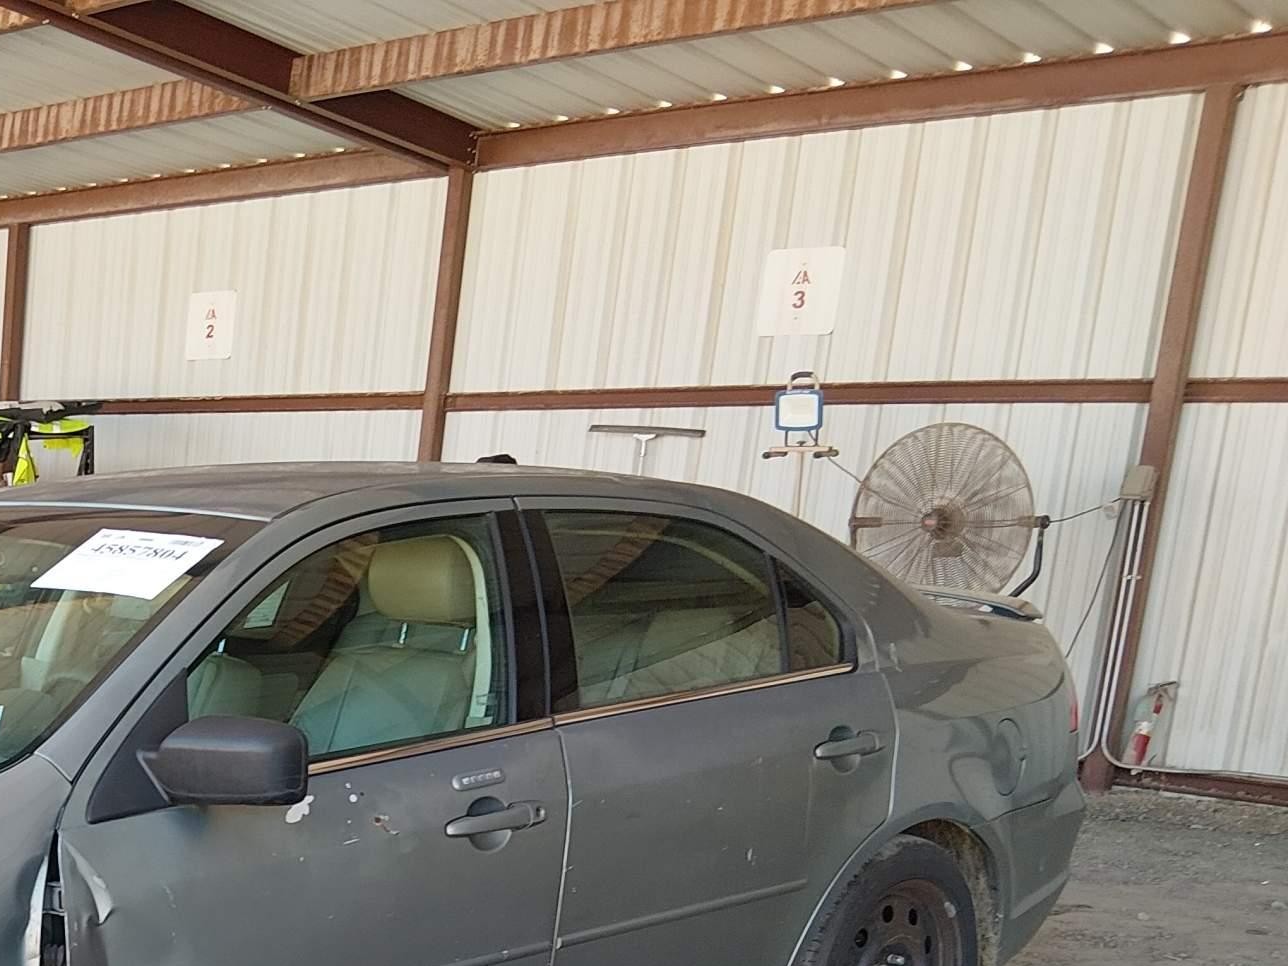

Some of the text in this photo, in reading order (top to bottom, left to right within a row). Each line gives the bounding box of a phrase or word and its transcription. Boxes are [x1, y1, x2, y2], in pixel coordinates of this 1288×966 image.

[792, 291, 806, 309] 3
[206, 324, 215, 339] 2
[91, 543, 189, 560] 45857804
